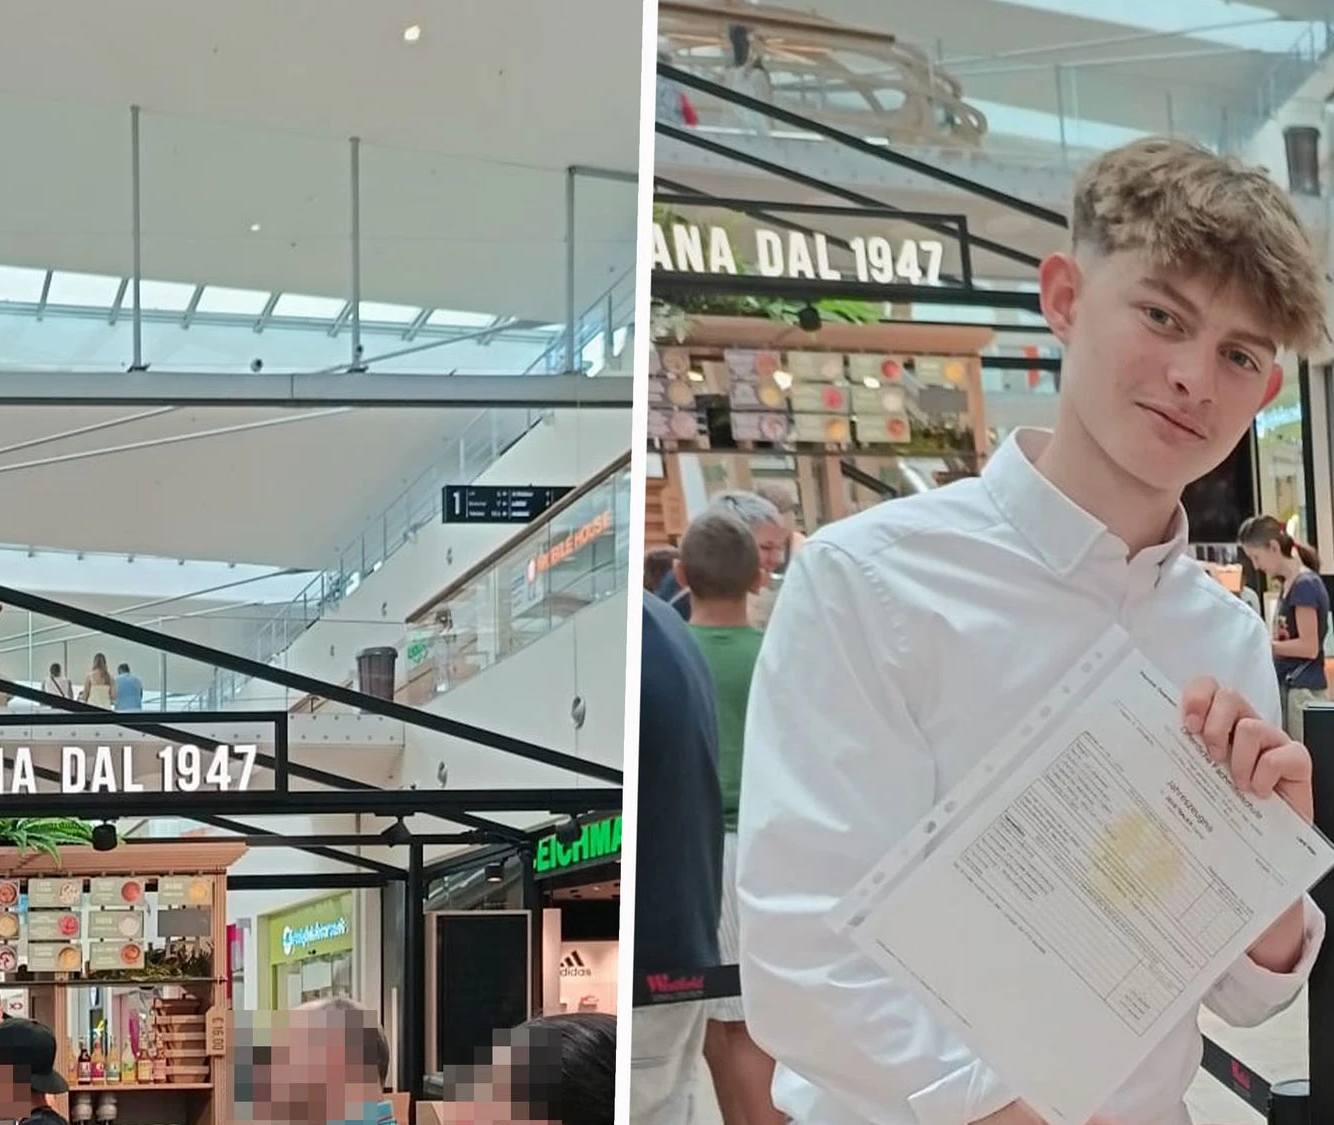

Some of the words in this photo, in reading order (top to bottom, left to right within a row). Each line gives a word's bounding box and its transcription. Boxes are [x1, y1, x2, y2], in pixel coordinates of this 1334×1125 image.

[755, 229, 841, 281] DAL
[849, 237, 944, 286] 1947
[453, 491, 460, 515] 1
[62, 745, 144, 794] DAL
[159, 744, 258, 793] 1947
[533, 816, 622, 872] EICHMA
[559, 966, 591, 977] didas
